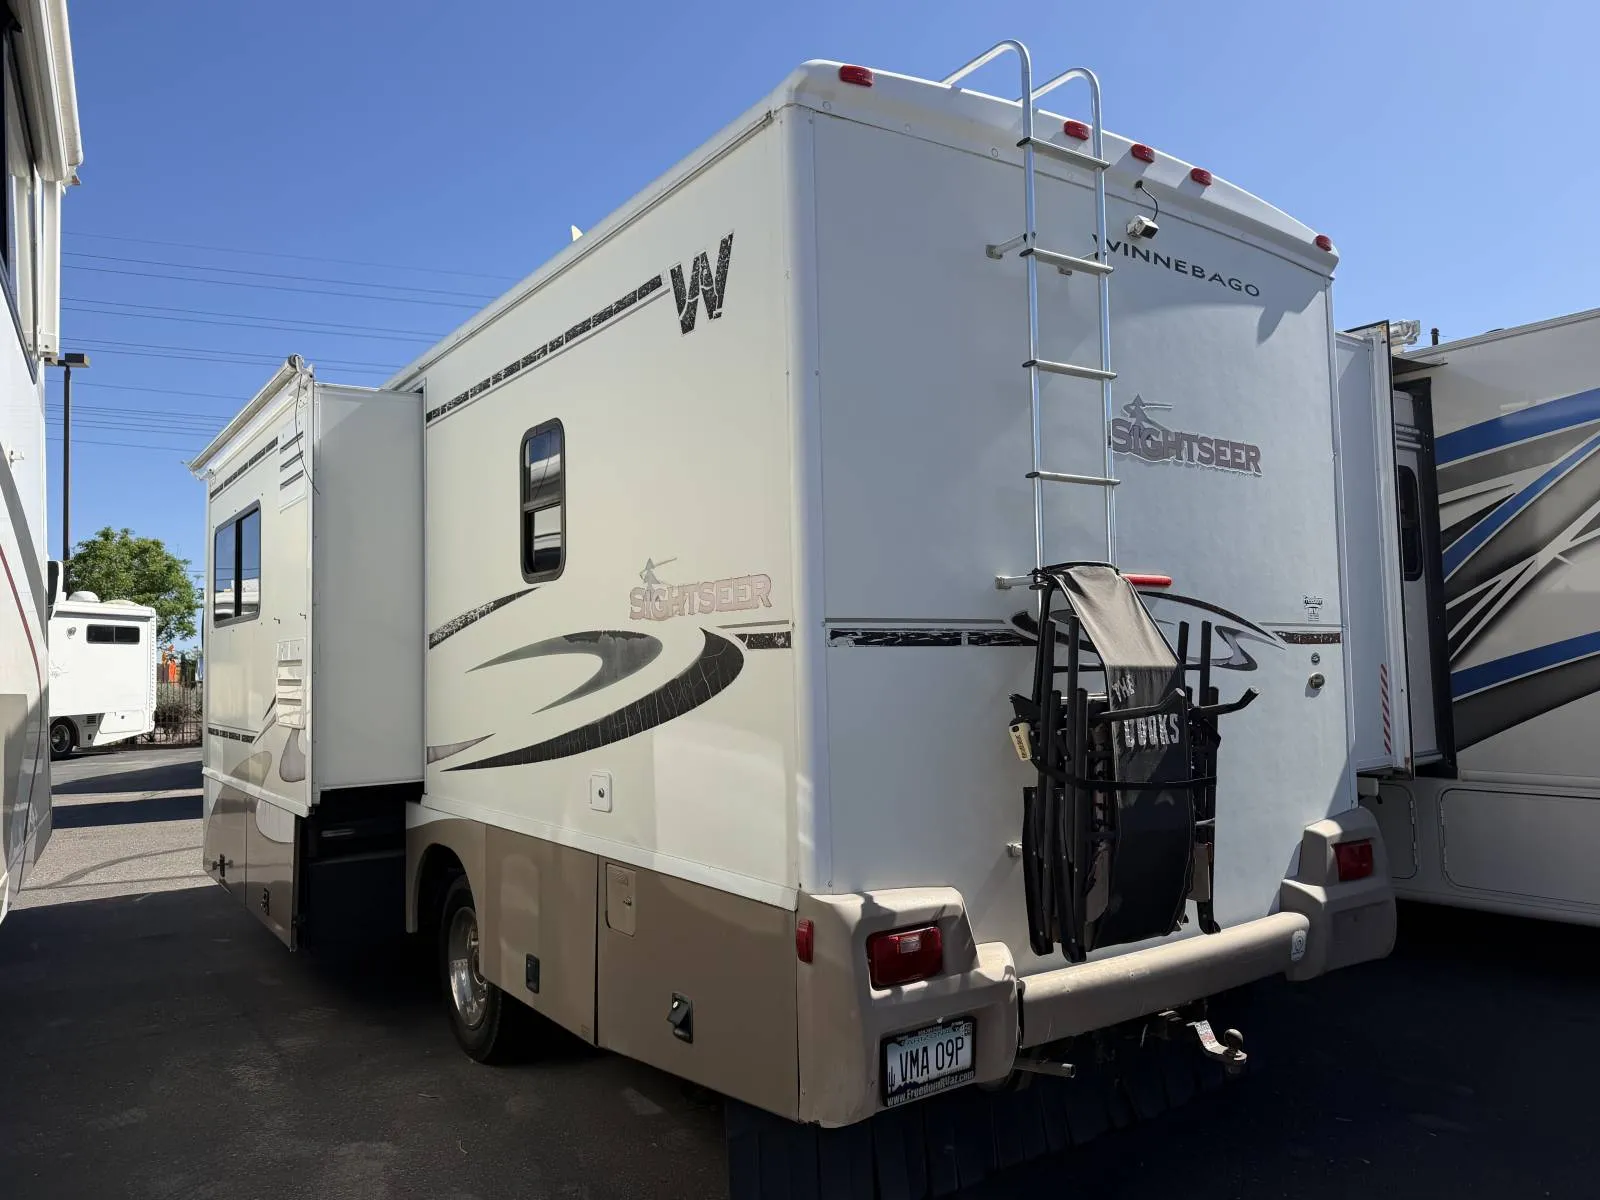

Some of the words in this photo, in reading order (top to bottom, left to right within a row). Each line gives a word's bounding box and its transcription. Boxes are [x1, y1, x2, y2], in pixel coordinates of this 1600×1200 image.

[1091, 233, 1260, 297] WINNEBAGO
[1110, 418, 1262, 476] SIGHTSEER
[629, 574, 773, 621] SIGHTSEER
[900, 1045, 930, 1082] VMA
